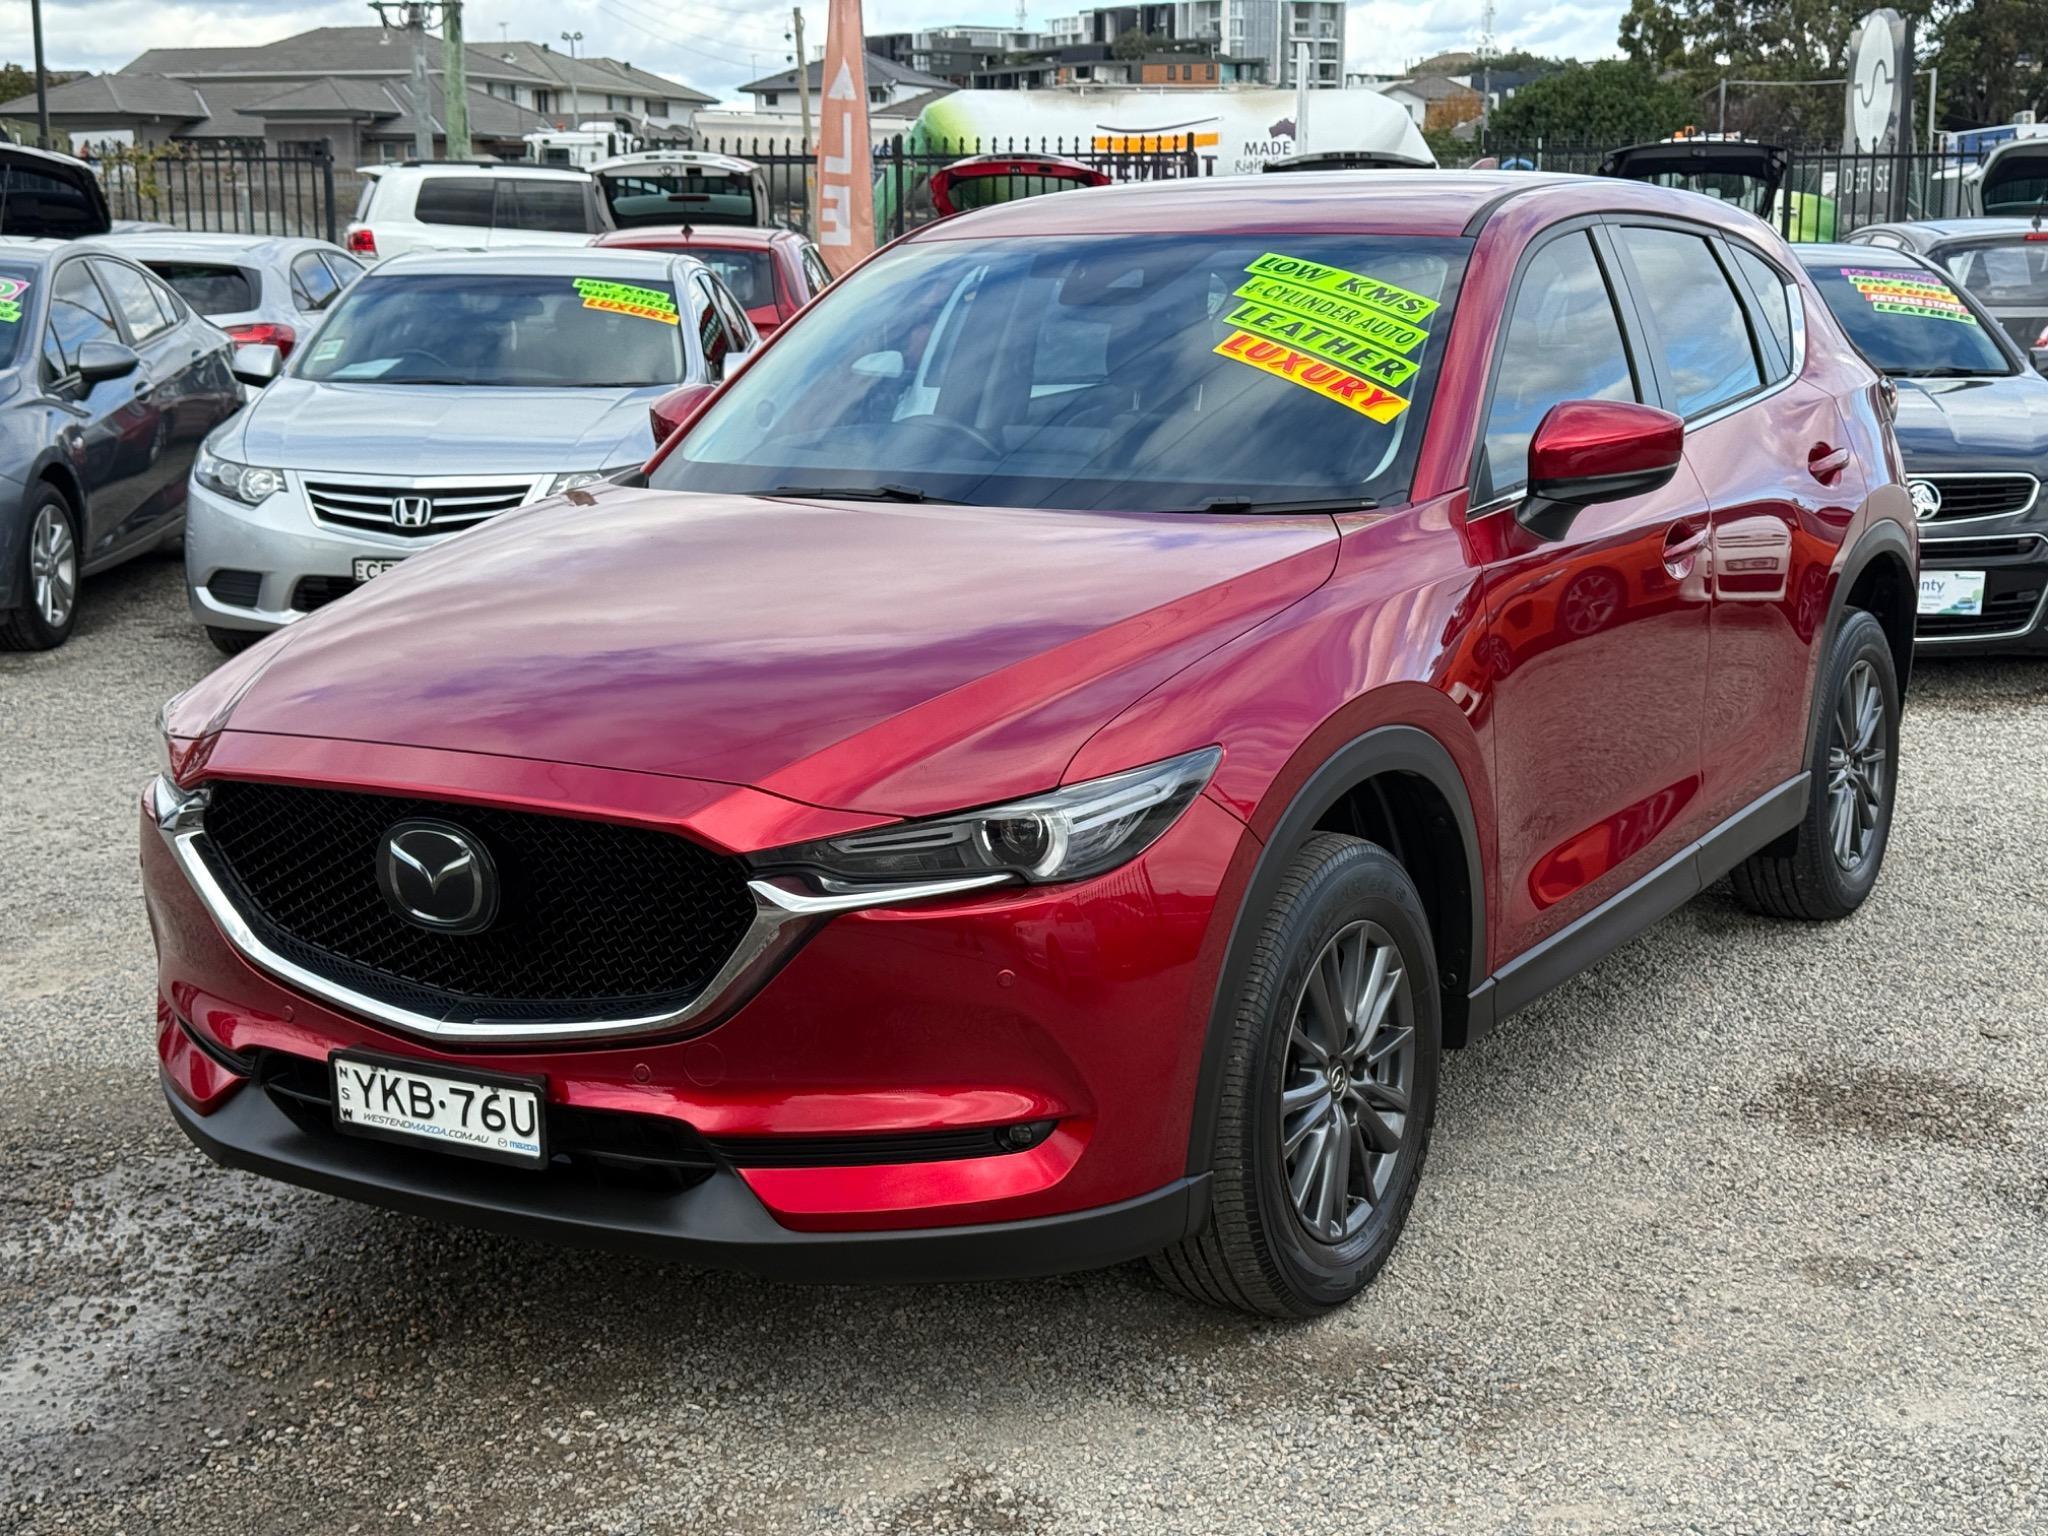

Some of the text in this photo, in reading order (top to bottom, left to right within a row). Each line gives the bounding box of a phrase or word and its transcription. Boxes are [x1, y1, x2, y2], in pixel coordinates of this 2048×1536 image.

[1244, 141, 1291, 156] MADE
[1095, 155, 1218, 181] EMET
[1257, 256, 1429, 314] LOW KMS
[1853, 276, 1892, 286] LOW
[1860, 284, 1956, 300] LUXURY
[1871, 293, 1965, 312] KEYLESS START
[587, 299, 678, 320] LUXURY
[1243, 281, 1417, 346] 4-CYLINDER AUTO
[1876, 303, 1974, 322] LEATHER
[1232, 306, 1409, 381] LEATHER
[1222, 334, 1403, 410] LUXURY
[1921, 579, 1945, 593] nty
[363, 1113, 539, 1153] WESTENDMAZDA.COM.AU mazda
